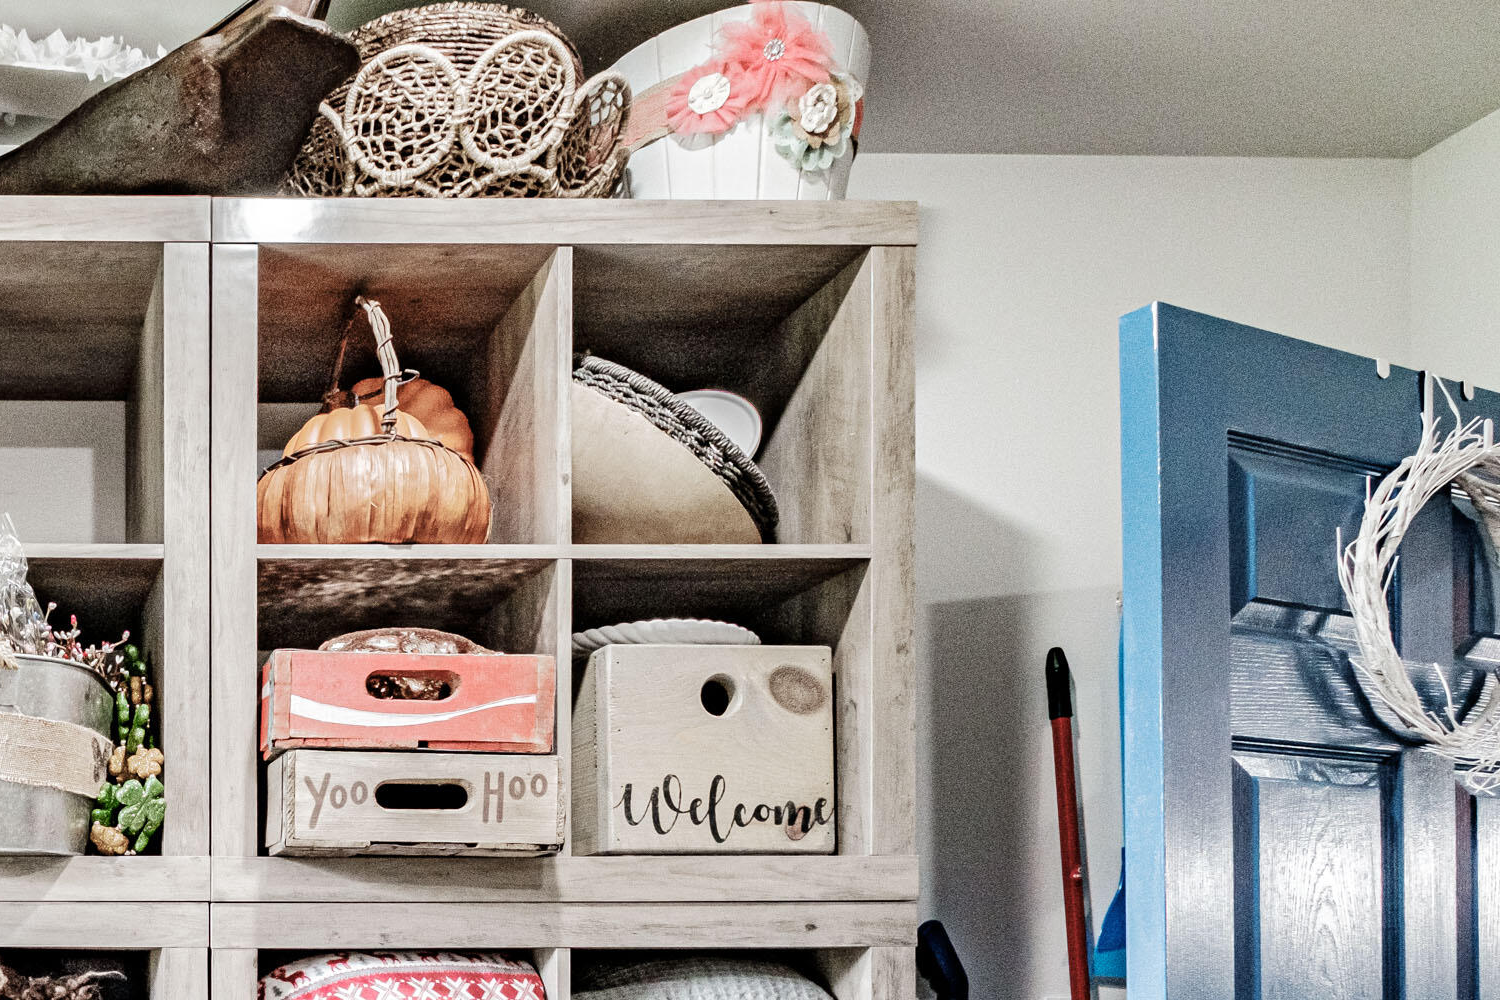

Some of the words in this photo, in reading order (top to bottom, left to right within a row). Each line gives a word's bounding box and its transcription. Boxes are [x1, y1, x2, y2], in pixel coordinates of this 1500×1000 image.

[303, 772, 369, 830] Yoo
[482, 770, 549, 824] Hoo
[612, 773, 835, 844] Welcome
